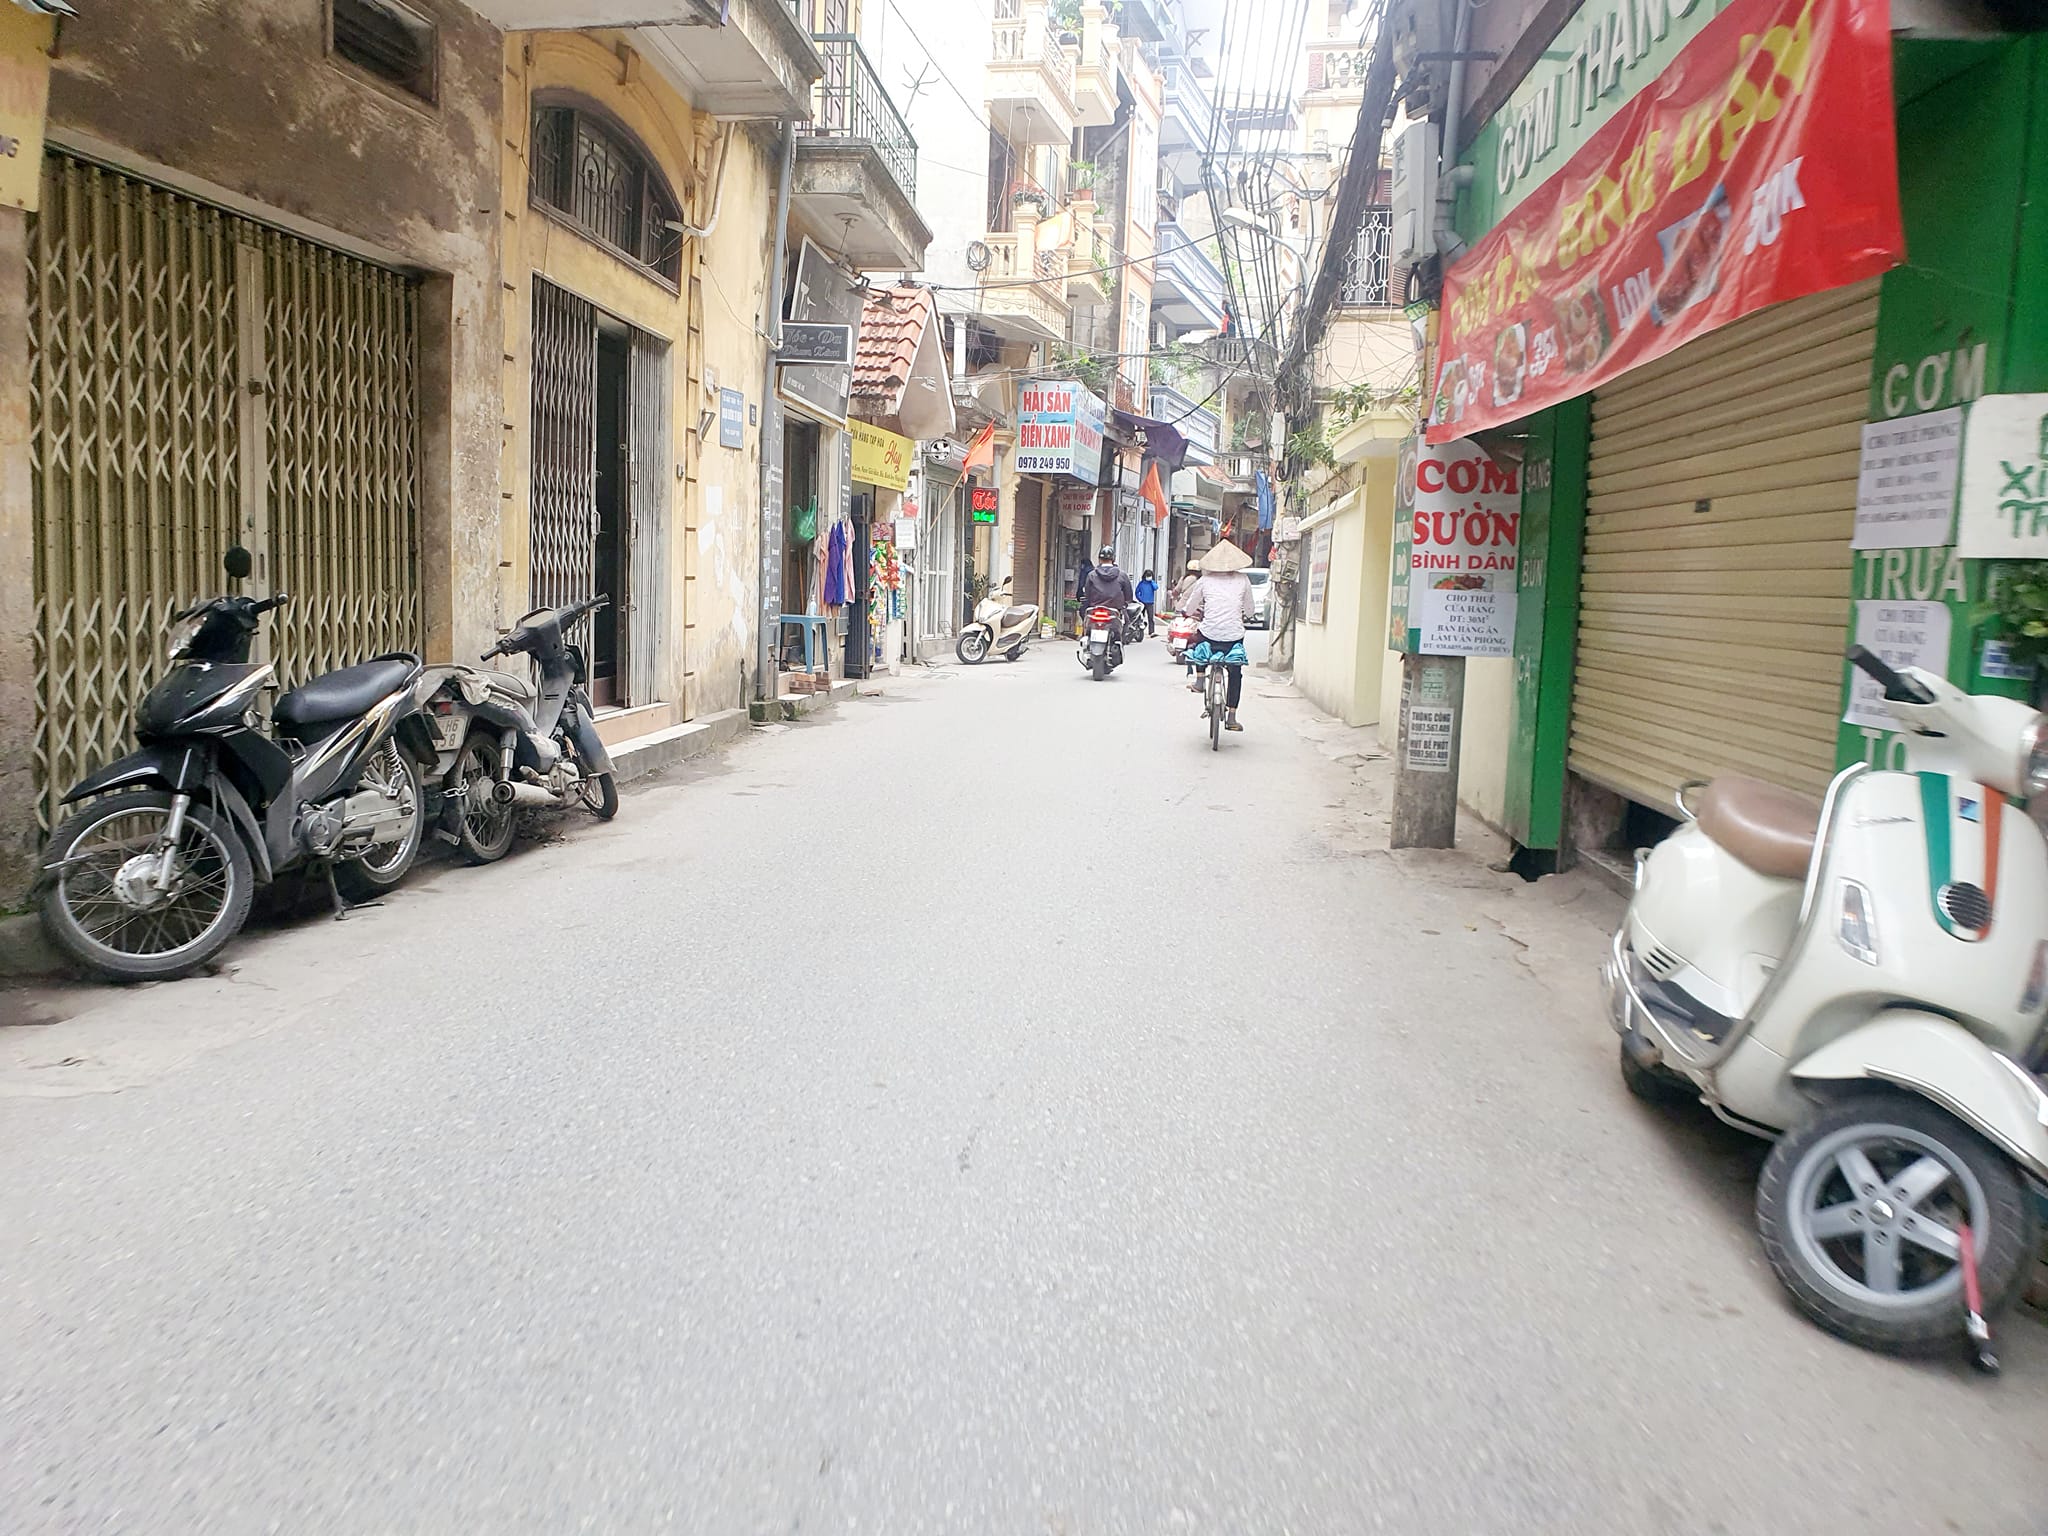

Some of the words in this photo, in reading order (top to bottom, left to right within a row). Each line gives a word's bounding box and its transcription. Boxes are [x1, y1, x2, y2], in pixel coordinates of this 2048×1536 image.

[1567, 0, 1695, 128] THAN
[1883, 343, 1987, 417] CƠM
[1023, 384, 1045, 412] HẢI
[1047, 384, 1071, 413] SẢN
[1020, 414, 1043, 448] BIỂN
[1044, 425, 1071, 448] XANH
[1018, 456, 1038, 469] 0978
[1039, 457, 1054, 469] 249
[1055, 457, 1071, 470] 950
[1416, 457, 1520, 495] CƠM
[1413, 502, 1521, 547] SƯỜN
[1411, 551, 1460, 570] BÌNH
[1467, 551, 1516, 571] DÂN
[1446, 594, 1468, 602] CHO
